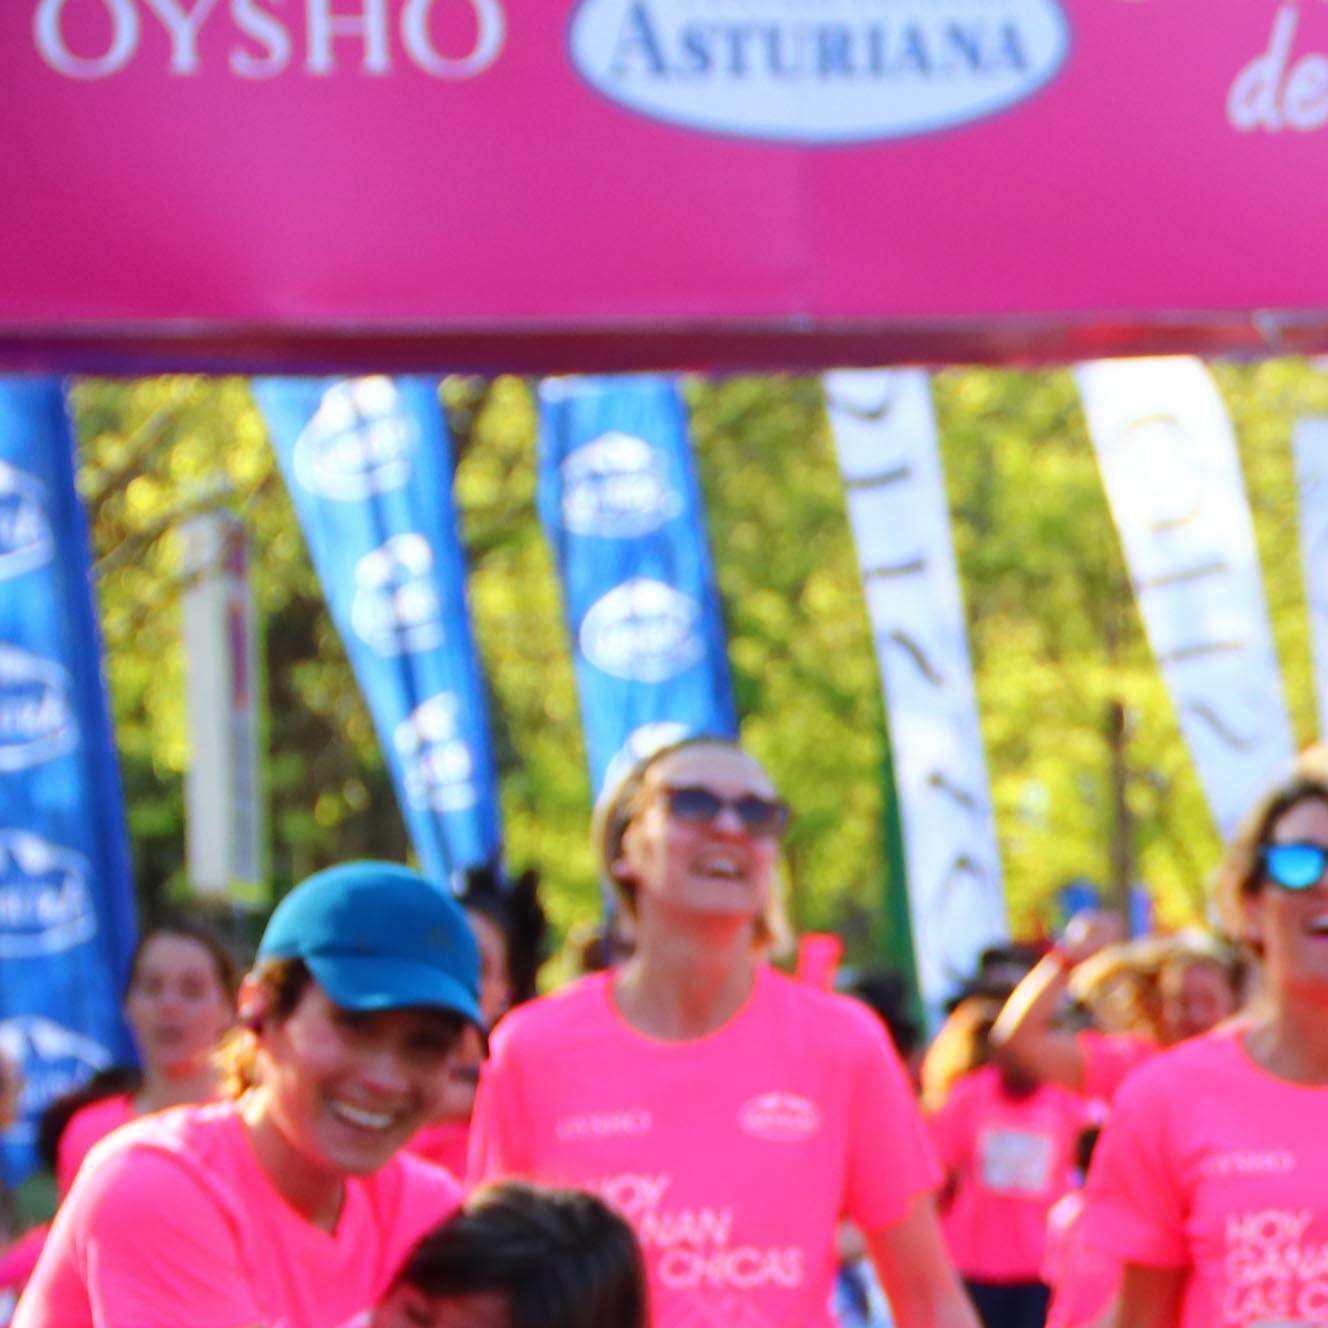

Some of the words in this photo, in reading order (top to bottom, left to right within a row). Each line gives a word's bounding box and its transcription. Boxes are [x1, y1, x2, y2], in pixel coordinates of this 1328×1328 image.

[34, 0, 506, 80] OYSHO
[608, 0, 1028, 80] ASTURIANA
[640, 1208, 734, 1250] NAN
[1224, 1208, 1313, 1252] HOY
[658, 1246, 803, 1289] CHICAS
